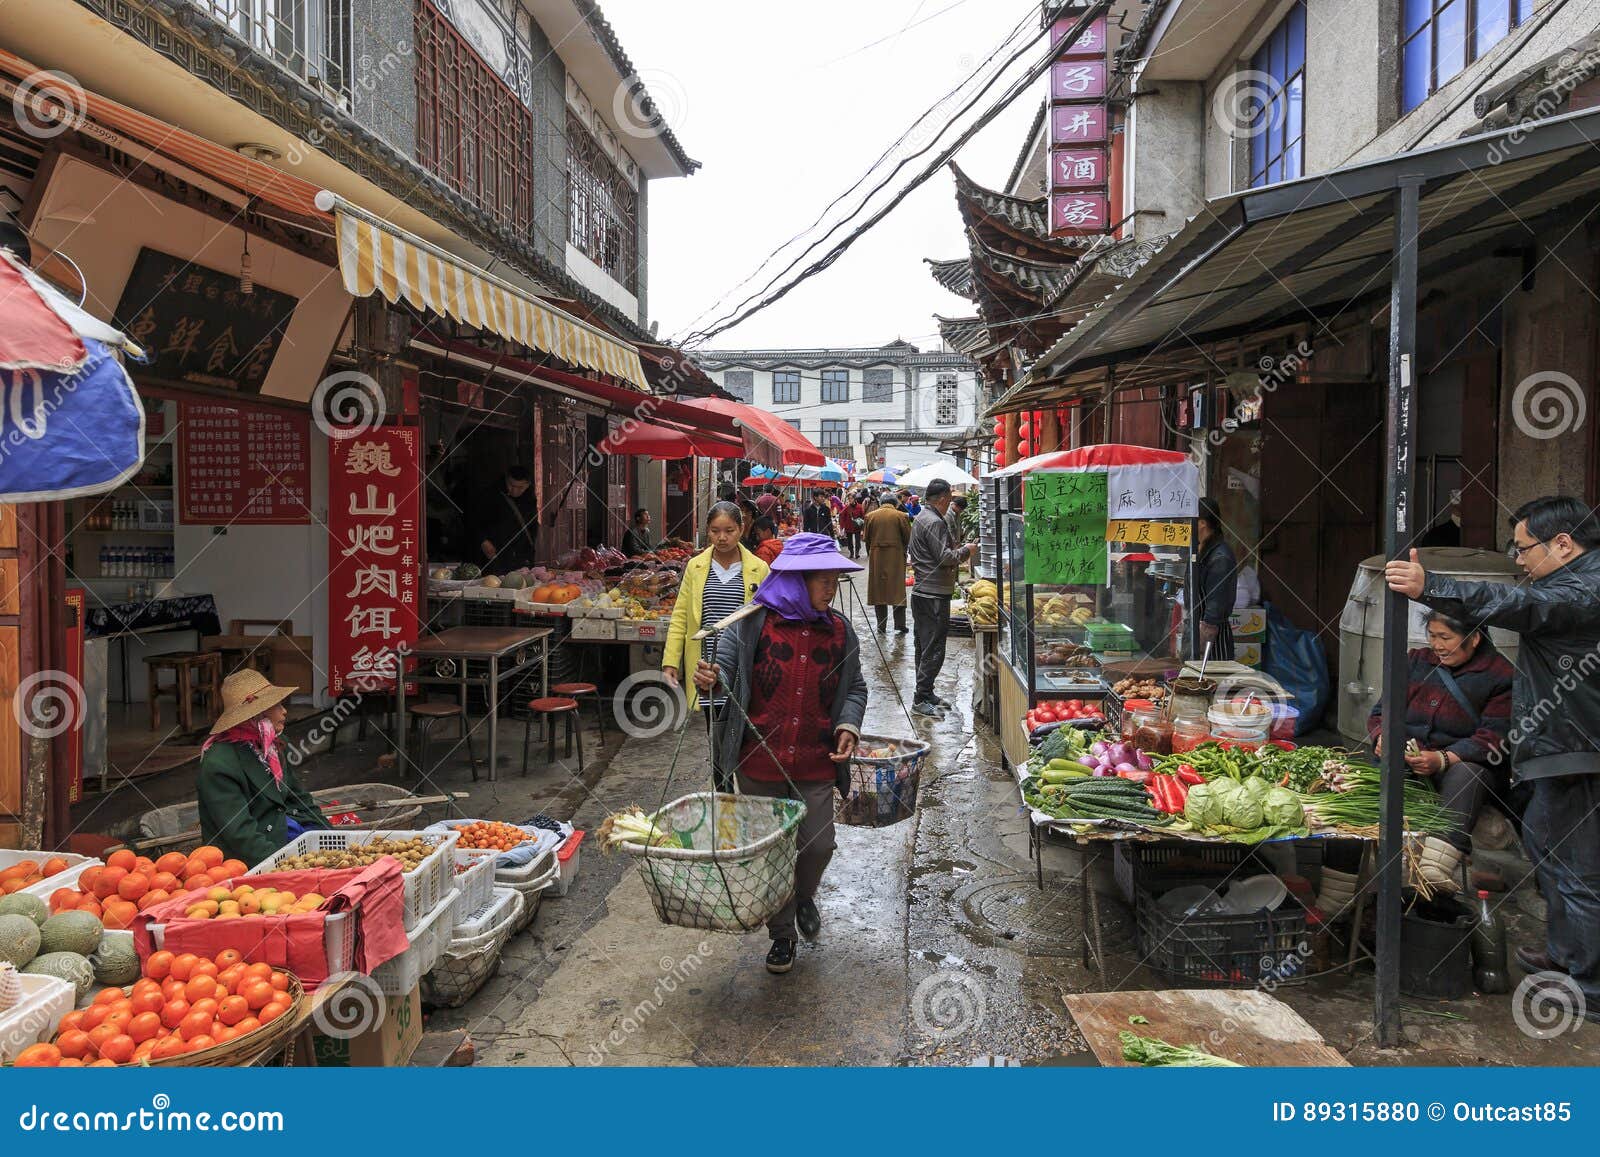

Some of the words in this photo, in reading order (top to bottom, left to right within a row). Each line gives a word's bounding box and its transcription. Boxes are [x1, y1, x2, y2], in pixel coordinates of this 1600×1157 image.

[401, 519, 414, 603] 三十年老店
